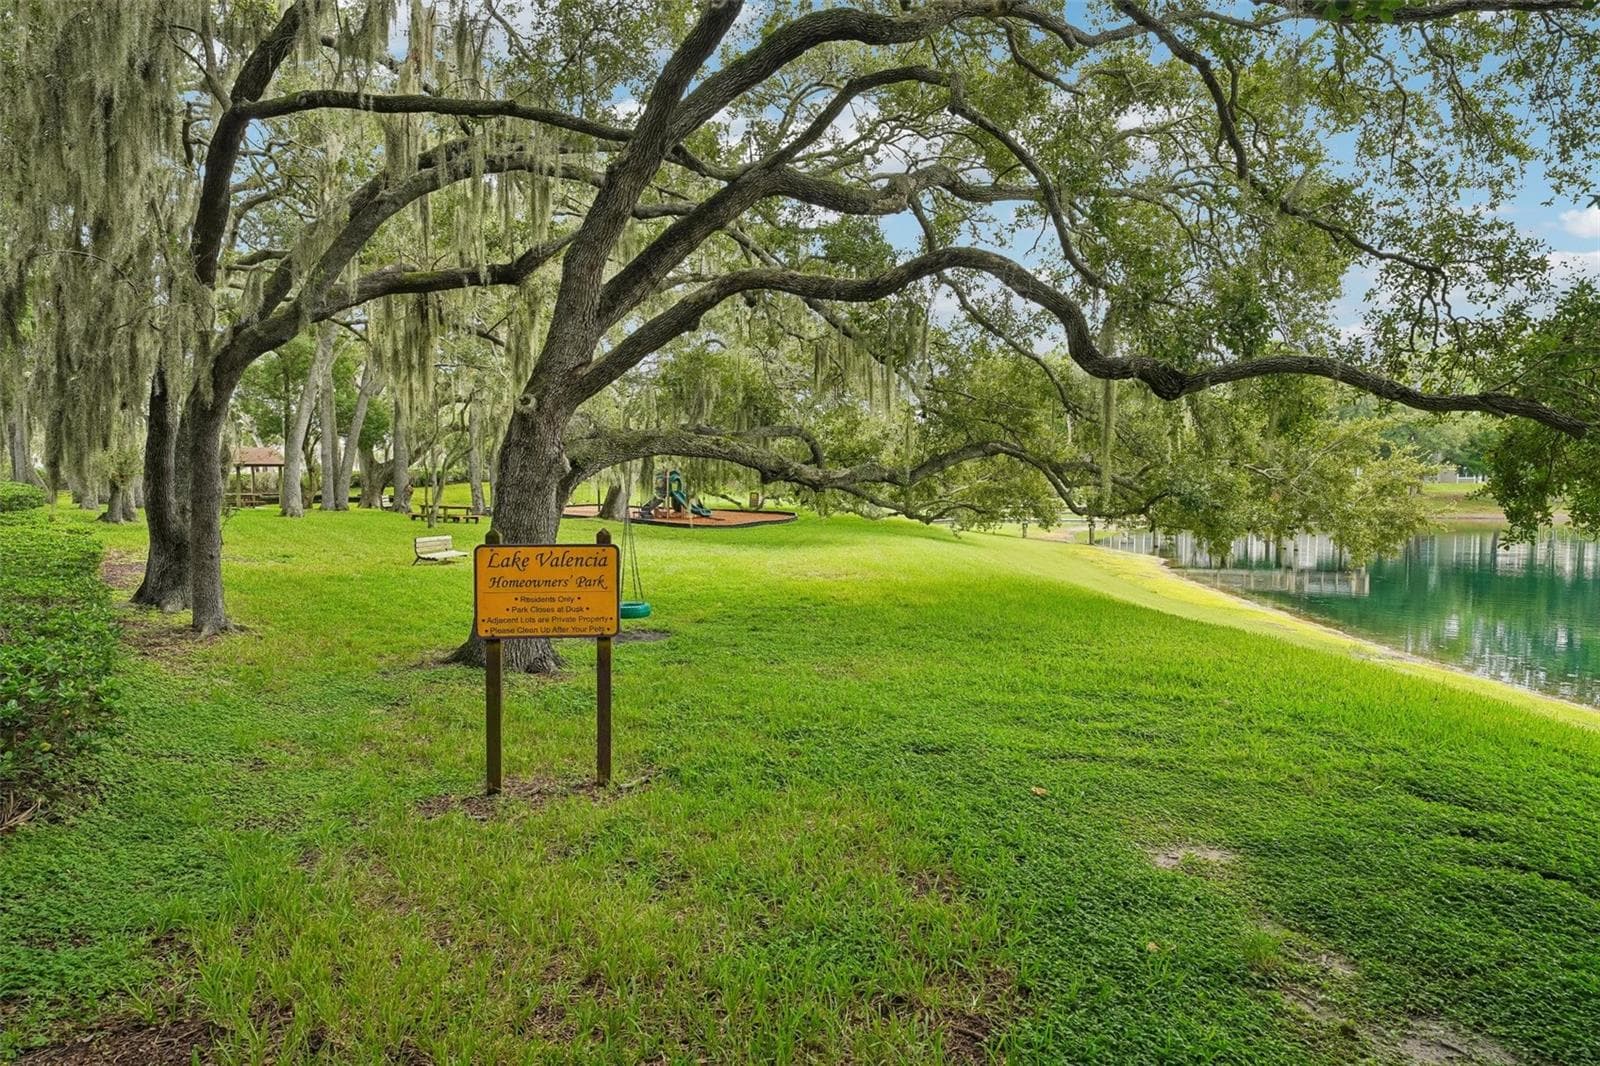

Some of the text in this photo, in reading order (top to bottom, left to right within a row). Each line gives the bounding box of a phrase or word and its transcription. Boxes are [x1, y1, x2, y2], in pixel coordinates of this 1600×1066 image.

[487, 550, 608, 572] Lake Valencia
[575, 575, 608, 589] Park
[487, 617, 518, 625] Adjacent
